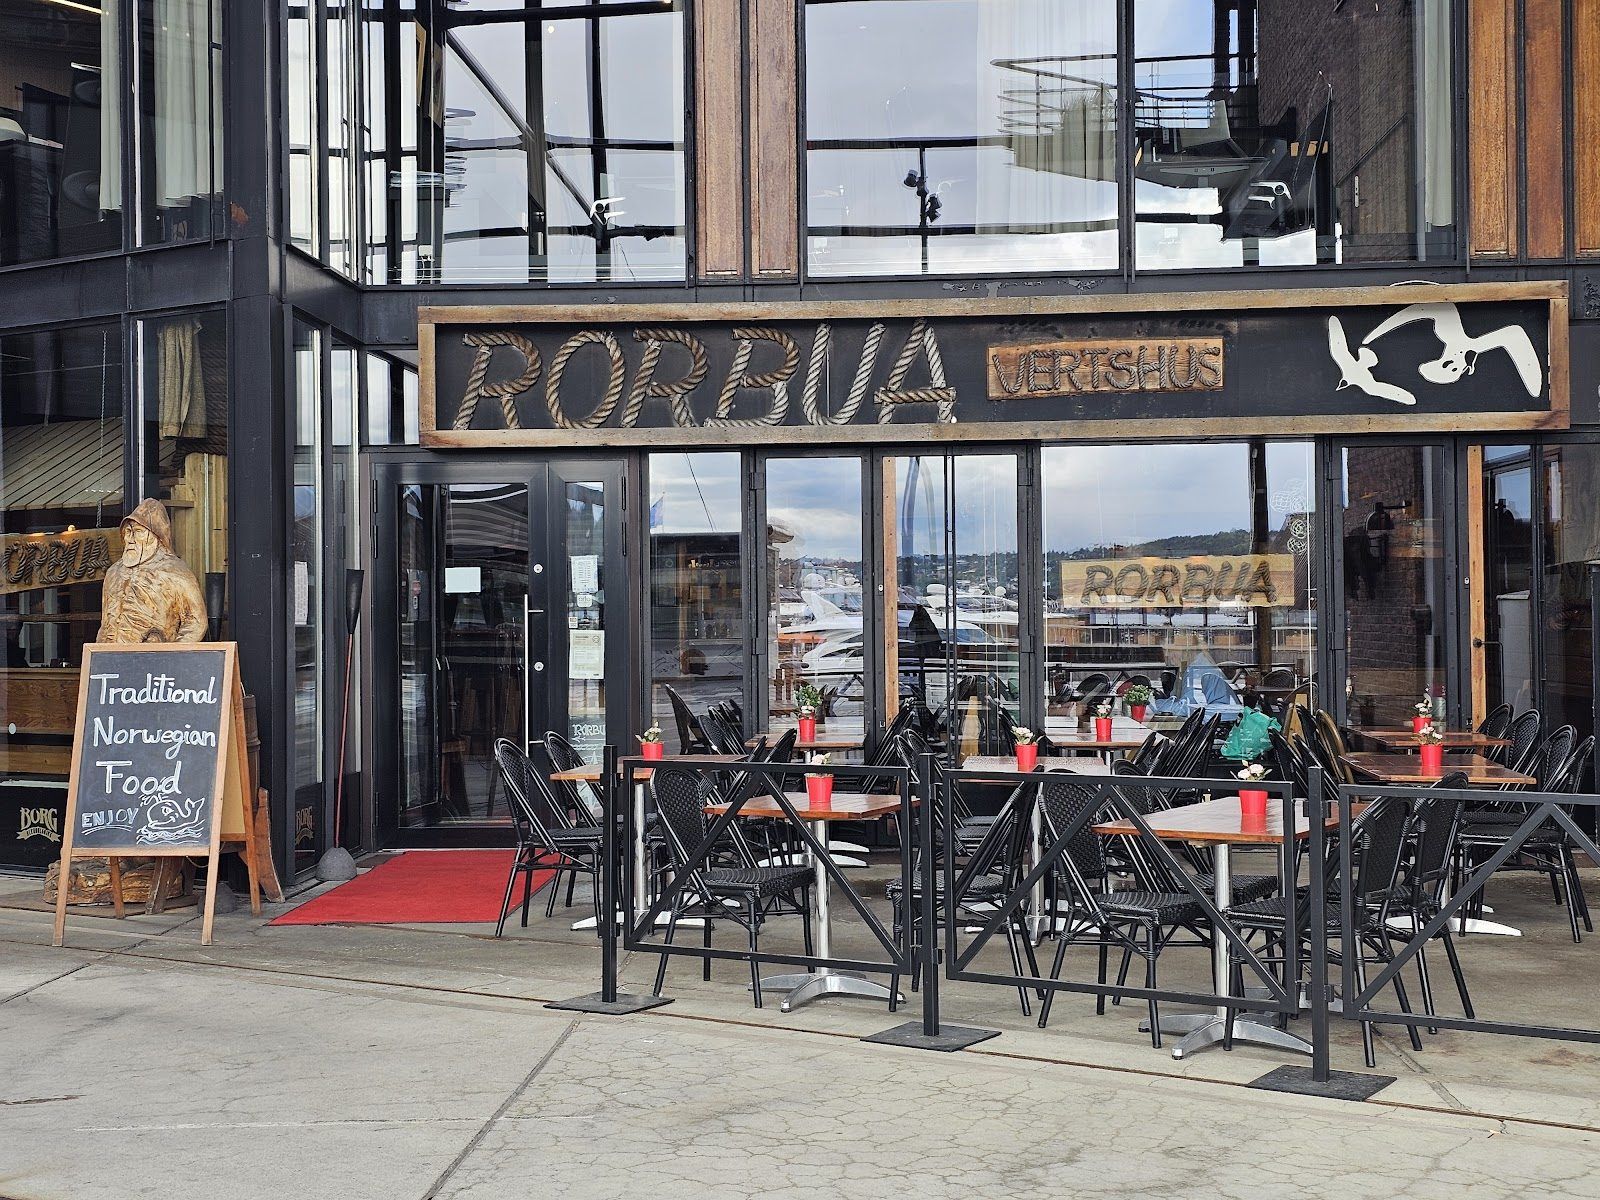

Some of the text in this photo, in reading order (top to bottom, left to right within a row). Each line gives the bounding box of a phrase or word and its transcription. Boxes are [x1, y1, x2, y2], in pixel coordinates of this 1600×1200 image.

[452, 318, 957, 430] RORBUA
[992, 345, 1221, 394] VERTSHUS
[1080, 560, 1277, 606] RORBUA
[90, 673, 217, 705] Traditional
[93, 716, 216, 760] Norwegian
[96, 761, 182, 795] Food
[20, 807, 58, 833] BORG
[81, 807, 139, 828] ENJOY
